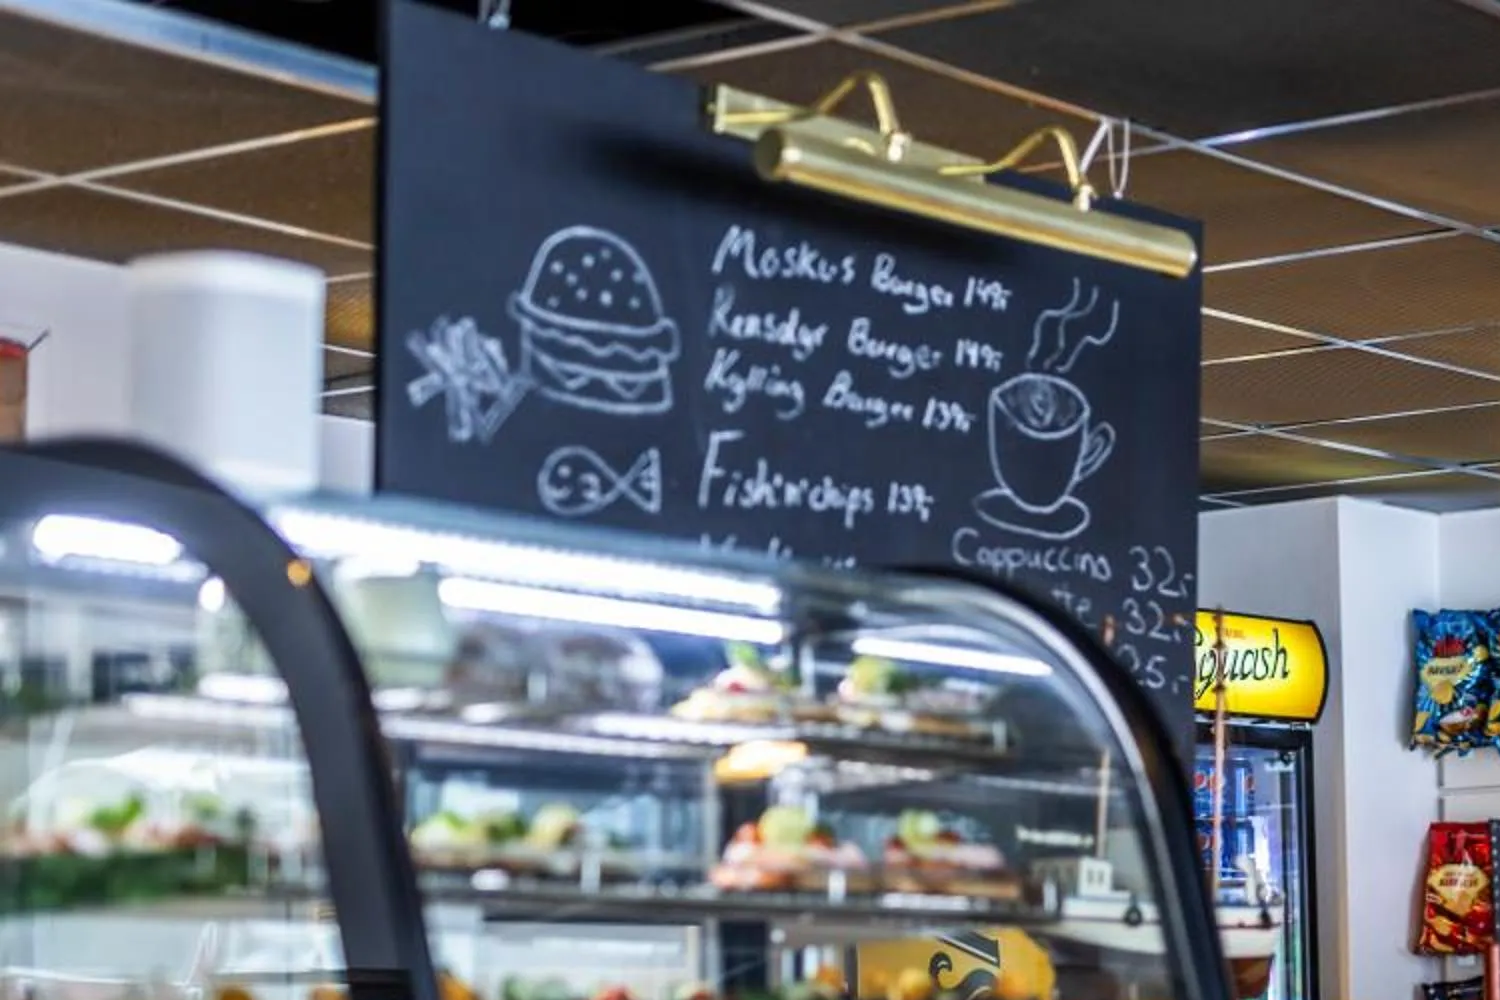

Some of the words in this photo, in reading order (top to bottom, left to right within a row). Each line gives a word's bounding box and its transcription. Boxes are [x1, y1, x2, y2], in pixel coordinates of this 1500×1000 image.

[711, 224, 855, 285] Moskus
[871, 253, 954, 314] Burger
[708, 282, 829, 362] Rensdyr
[848, 317, 942, 378] Burger
[704, 347, 805, 420] Kylling
[822, 369, 913, 428] Burger
[952, 527, 1112, 581] Cappuccino
